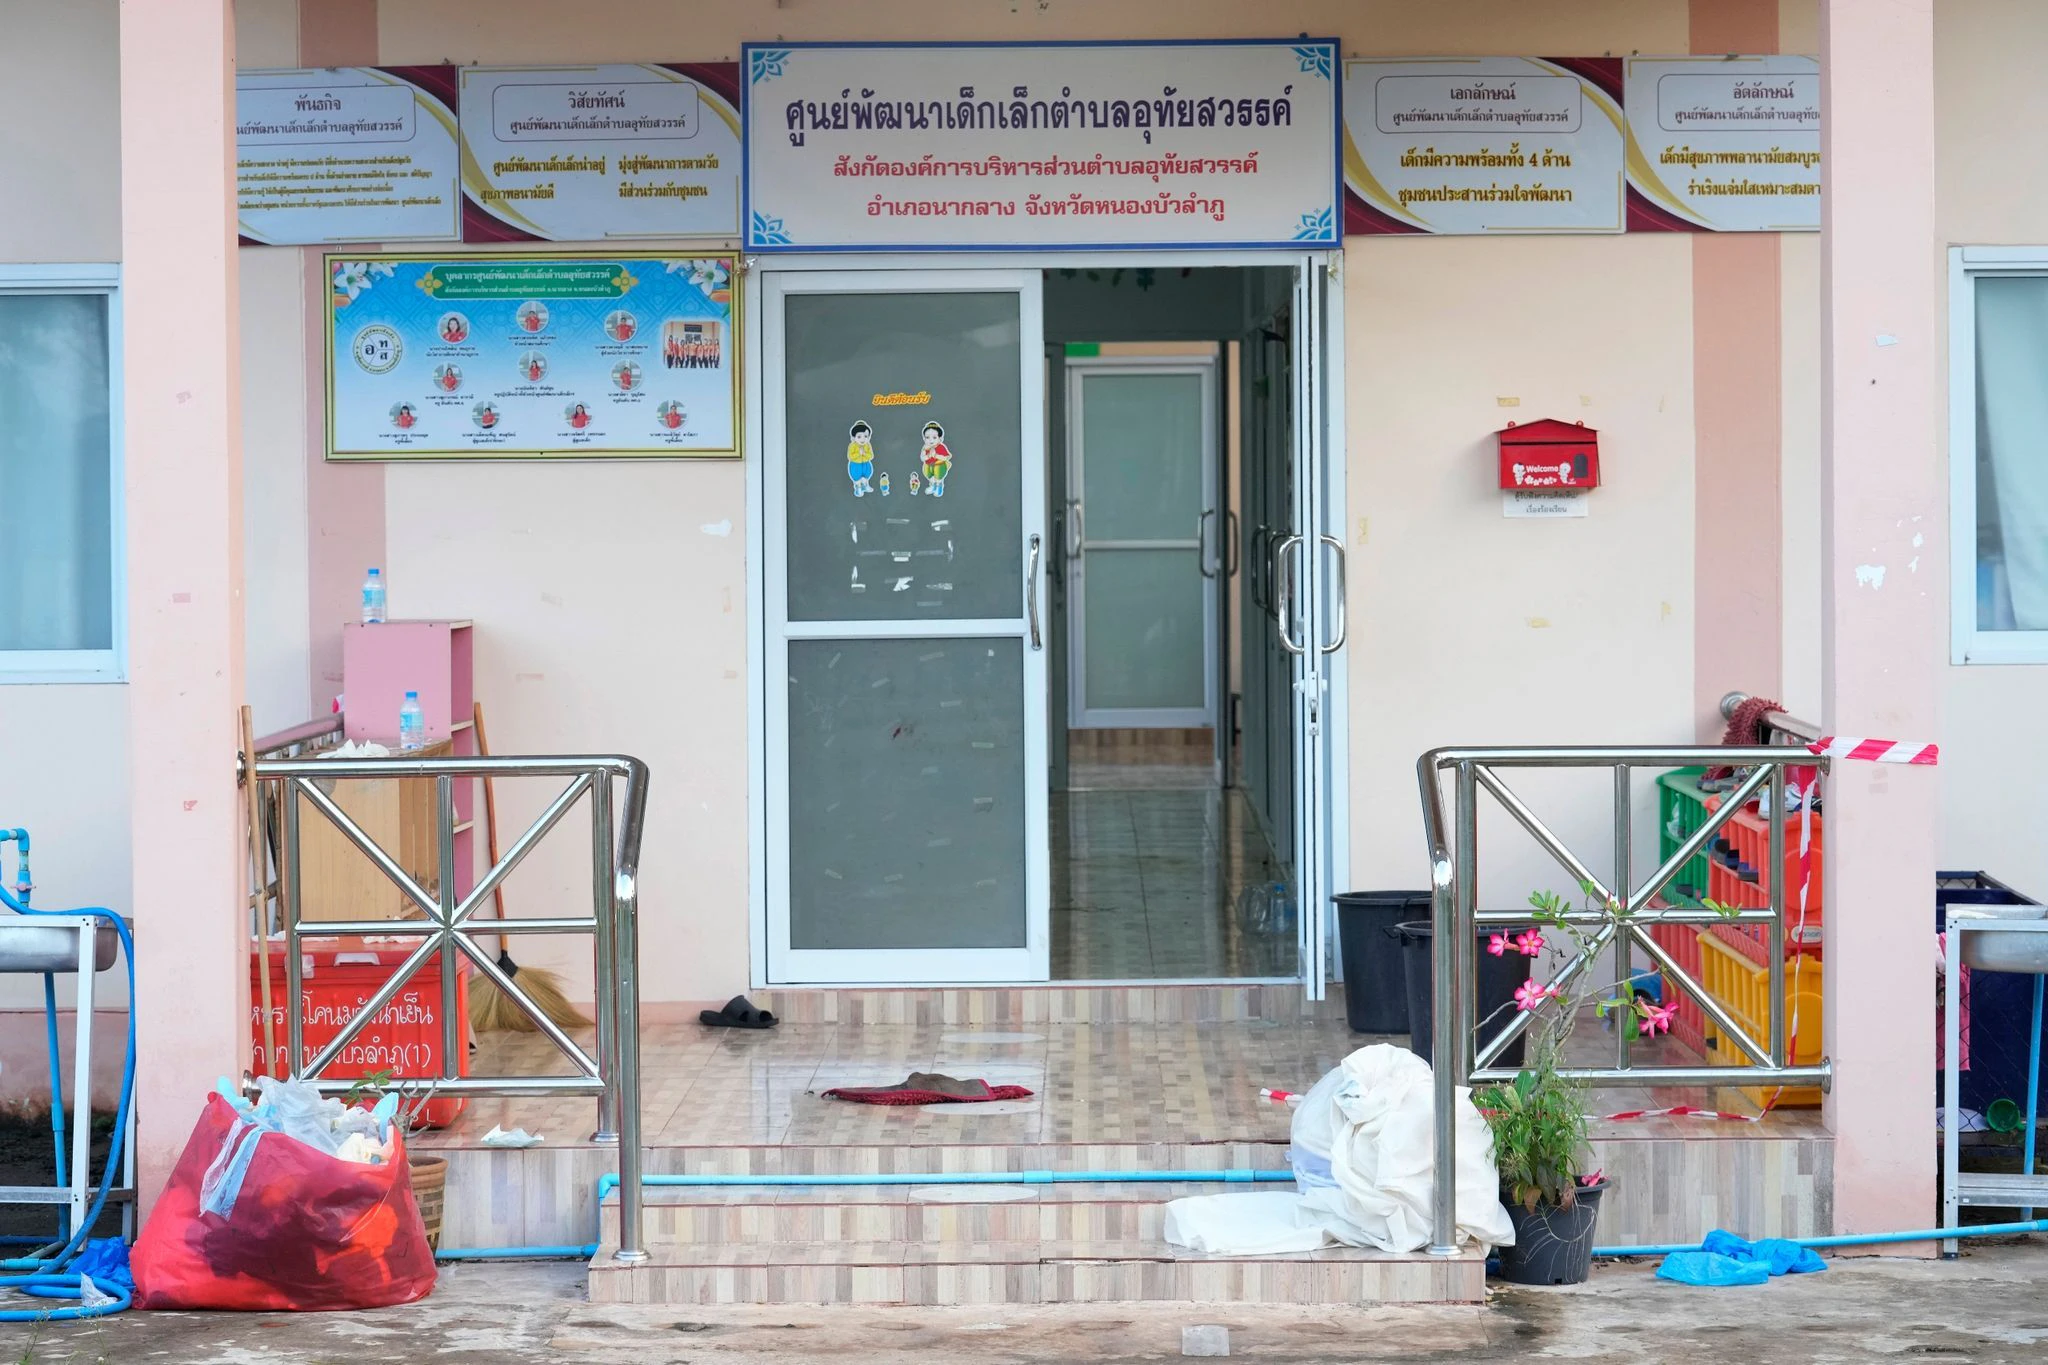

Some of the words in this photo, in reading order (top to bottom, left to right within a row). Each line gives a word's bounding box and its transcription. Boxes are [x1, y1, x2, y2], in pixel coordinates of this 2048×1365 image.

[568, 90, 626, 109] วิสัยทัศน์
[1450, 82, 1517, 101] เอกลักษณ์
[295, 93, 342, 112] พันธกิจ
[786, 85, 1293, 147] ศูนย์พัฒนาเด็กเล็กตำบลอุทัยสวรรค์
[1392, 107, 1570, 127] ศูนย์พัฒนาเด็กเล็กตำบลอุทัยสวรรค์
[1674, 106, 1820, 126] ศูนย์พัฒนาเด็กเล็กตำบลอุทัย
[510, 117, 686, 136] ศูนย์พัฒนาเด็กเล็กตำบลอุทัยสวรรค์
[493, 154, 606, 177] ศูนย์พัฒนาเด็กเล็กน่าอยู่
[1400, 143, 1525, 168] เด็กมีความพร้อมทั้ง
[1528, 152, 1539, 168] 4
[1541, 148, 1572, 168] ด้าน
[834, 151, 1259, 184] สังกัดองค์การบริหารส่วนตำบลอุทัยสวรรค์
[480, 183, 555, 205] สุขภาพอนามัยดี
[618, 182, 709, 201] มีส่วนร่วมกับชุมชน
[1396, 182, 1573, 209] ชุมชนประสานร่วมใจพัฒนา
[867, 195, 1016, 218] อำเภอนากลาง
[1025, 191, 1227, 222] จังหวัดหนองบัวลำภู
[1525, 465, 1559, 473] Welcome
